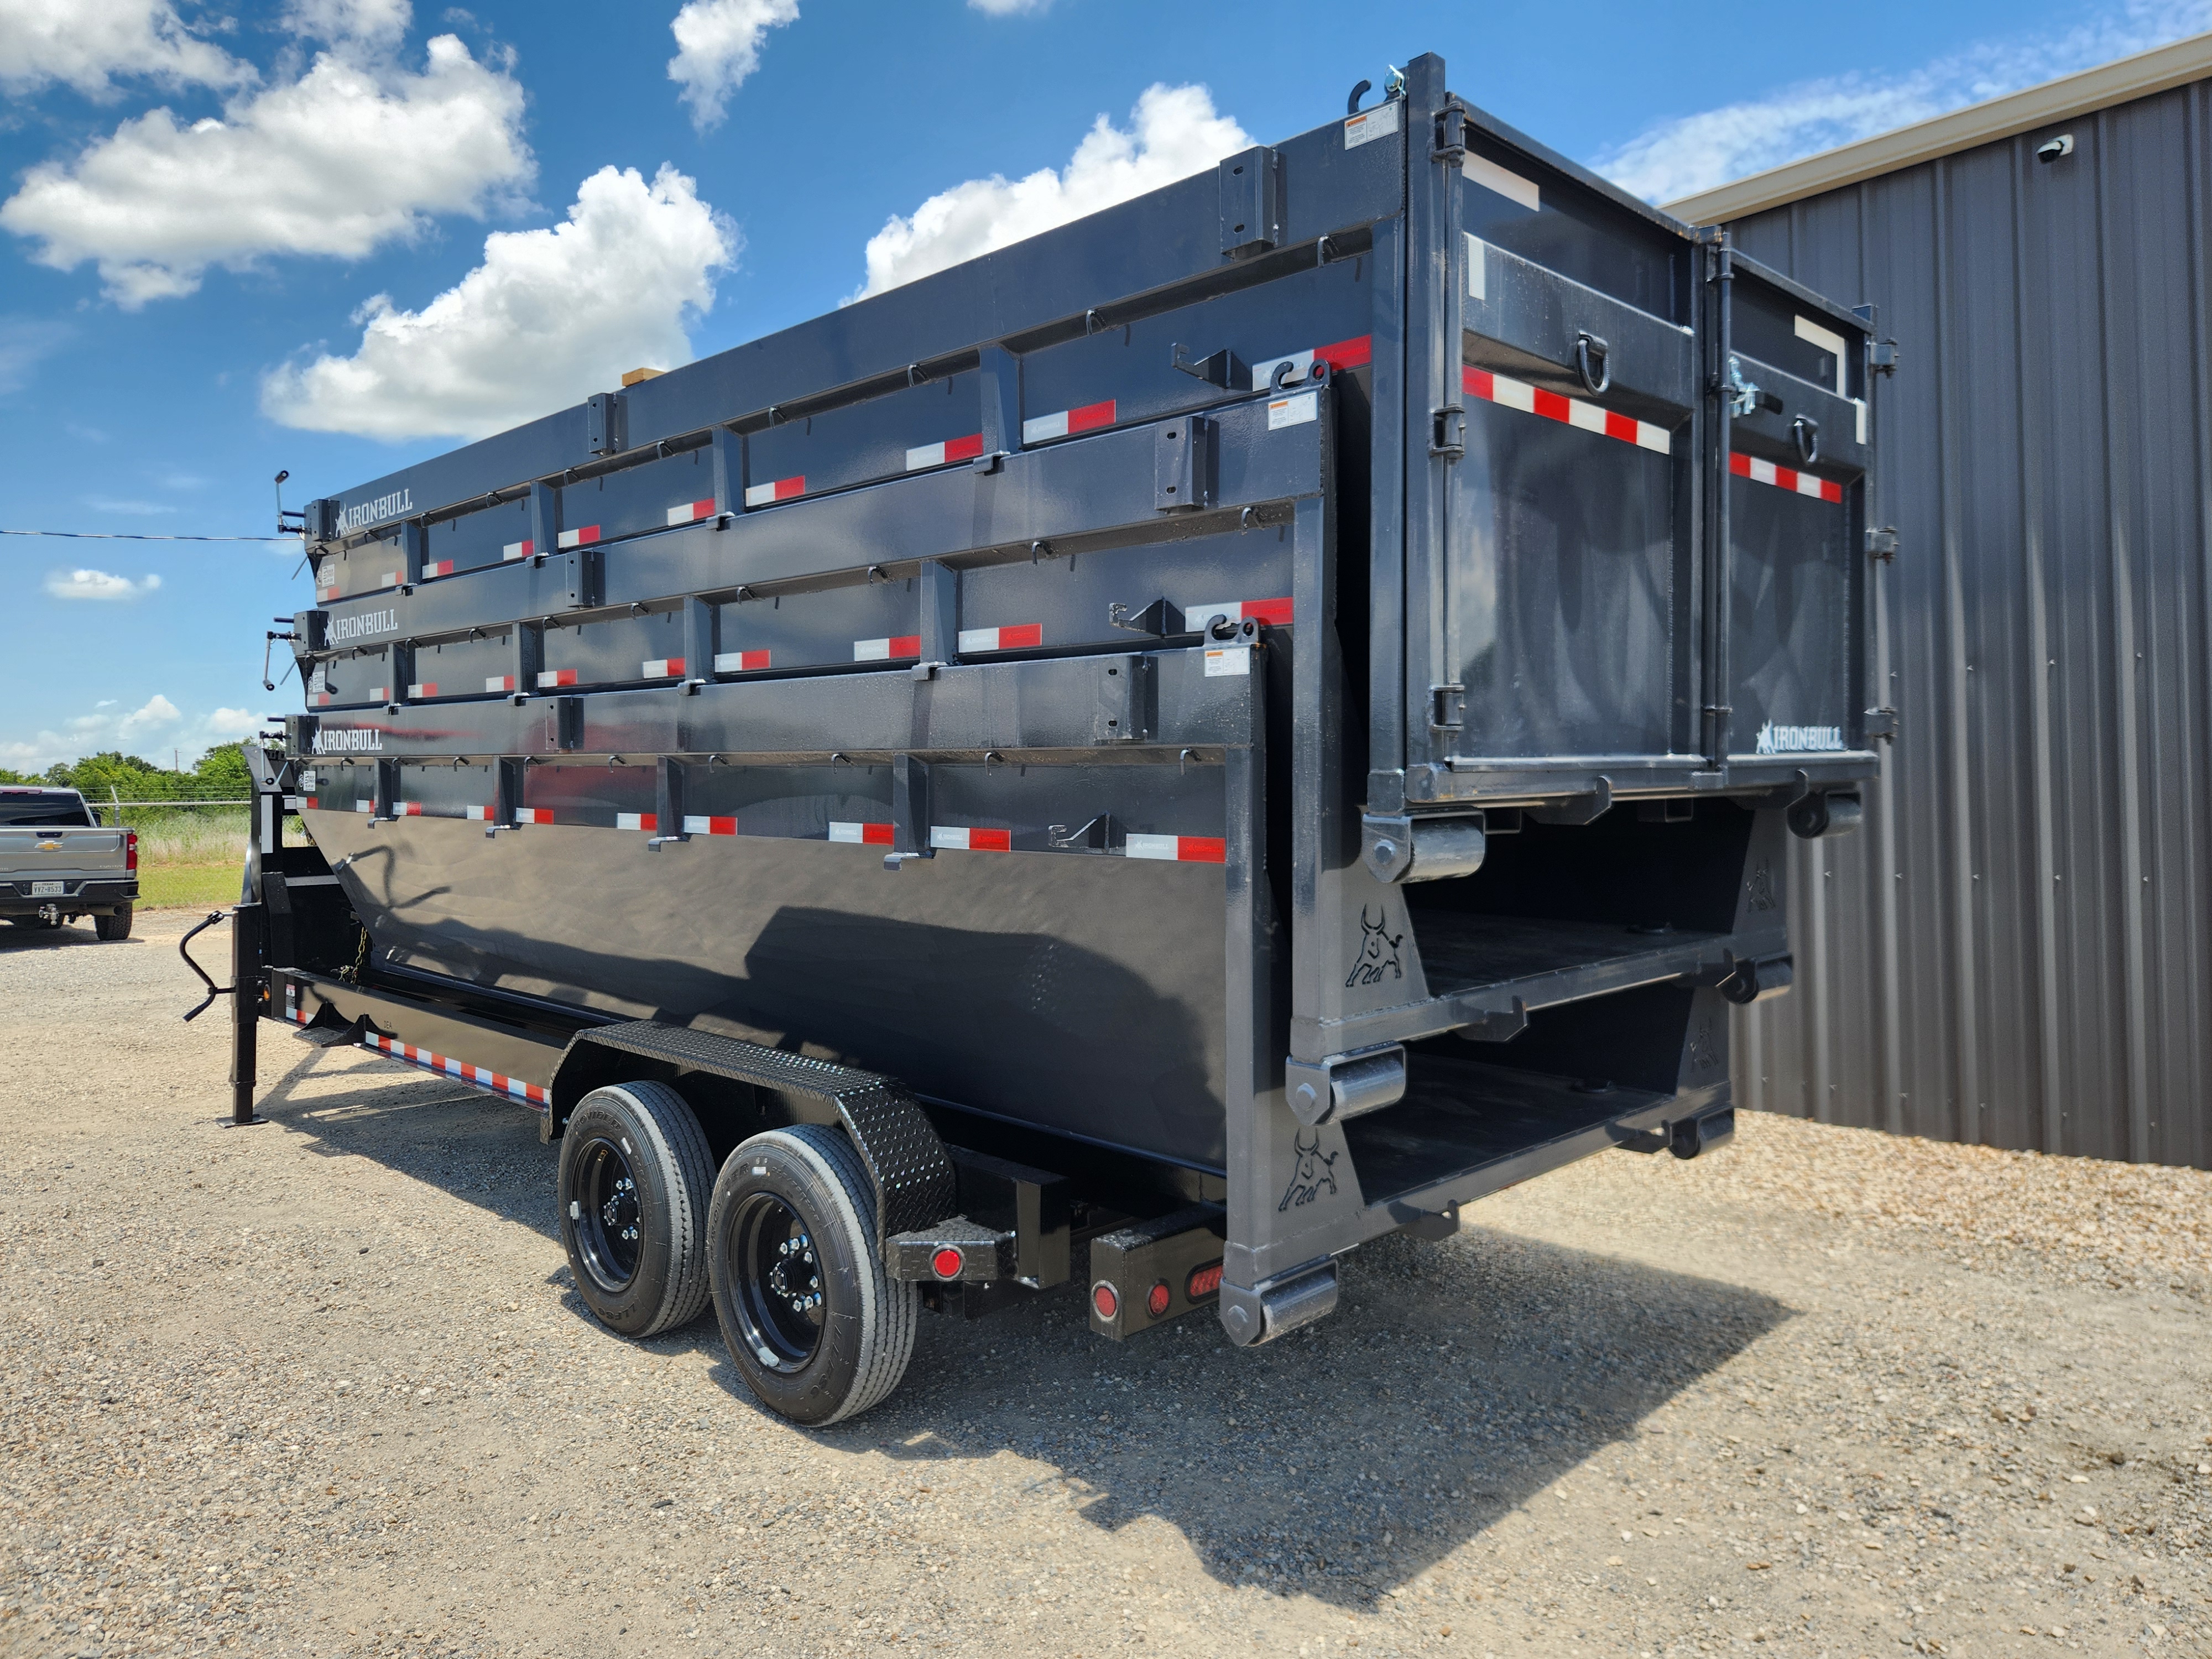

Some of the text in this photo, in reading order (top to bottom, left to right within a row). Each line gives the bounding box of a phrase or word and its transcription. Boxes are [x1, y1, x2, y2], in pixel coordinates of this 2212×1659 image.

[348, 488, 413, 530] IRONBULL
[336, 609, 398, 640] IRONBULL
[324, 729, 382, 752] IRONBULL
[1773, 726, 1844, 750] IRONBULL
[568, 1110, 622, 1140] PROVIDER
